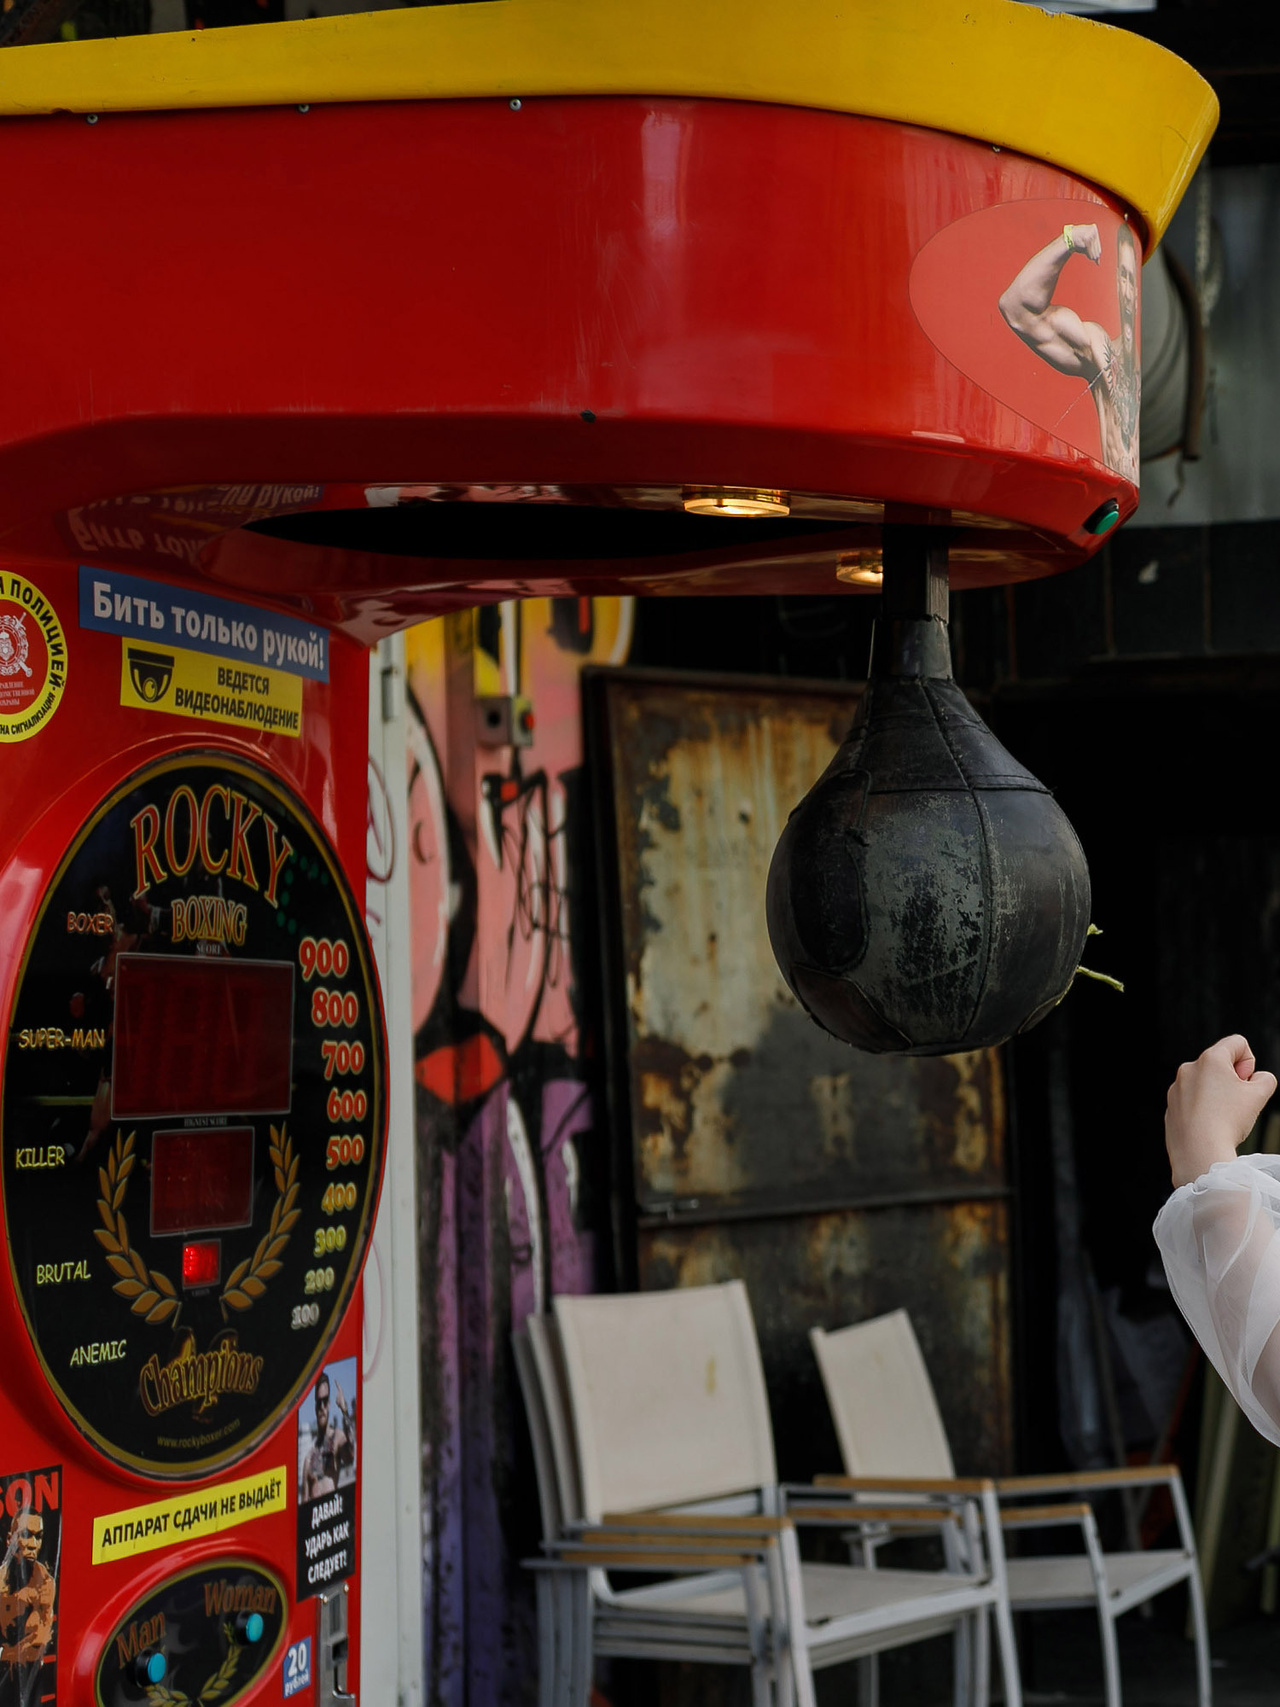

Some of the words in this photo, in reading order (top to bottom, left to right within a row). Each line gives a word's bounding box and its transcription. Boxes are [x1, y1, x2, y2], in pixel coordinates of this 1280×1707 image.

[10, 578, 65, 688] ПОЛИЦИЕЙ
[93, 581, 165, 629] Бить
[171, 606, 257, 651] только
[263, 631, 324, 671] рукой!
[217, 667, 269, 696] ВЕДЕТСЯ
[11, 692, 56, 735] СИГНАЛИЗАЦИЯ
[175, 687, 299, 730] ВИДЕОНАБЛЮДЕНИЕ
[130, 784, 293, 909] ROCKY
[66, 911, 114, 934] BOXER
[171, 895, 247, 947] BOXING
[299, 936, 349, 982] 900
[311, 987, 359, 1027] 800
[18, 1027, 105, 1049] SUPER-MAN
[321, 1039, 365, 1081] 700
[326, 1086, 368, 1123] 600
[15, 1145, 66, 1169] KILLER
[325, 1134, 365, 1171] 500
[321, 1182, 357, 1216] 400
[313, 1225, 347, 1258] 300
[36, 1259, 92, 1285] BRUTAL
[304, 1266, 335, 1295] 200
[291, 1303, 320, 1330] 100
[70, 1339, 127, 1367] ANEMIC
[140, 1347, 264, 1417] Champions
[102, 1513, 170, 1548] АППАРАТ
[173, 1501, 218, 1532] СДАЧИ
[220, 1495, 236, 1516] НЕ
[238, 1478, 281, 1510] ВЫДАЁТ
[311, 1494, 343, 1530] ДАВАЙ!
[305, 1528, 332, 1560] УДАРЬ
[332, 1520, 350, 1543] КАК
[307, 1549, 347, 1584] СЛЕДУЕТ!
[203, 1579, 278, 1618] Woman
[115, 1611, 167, 1670] Man
[287, 1642, 307, 1678] 20
